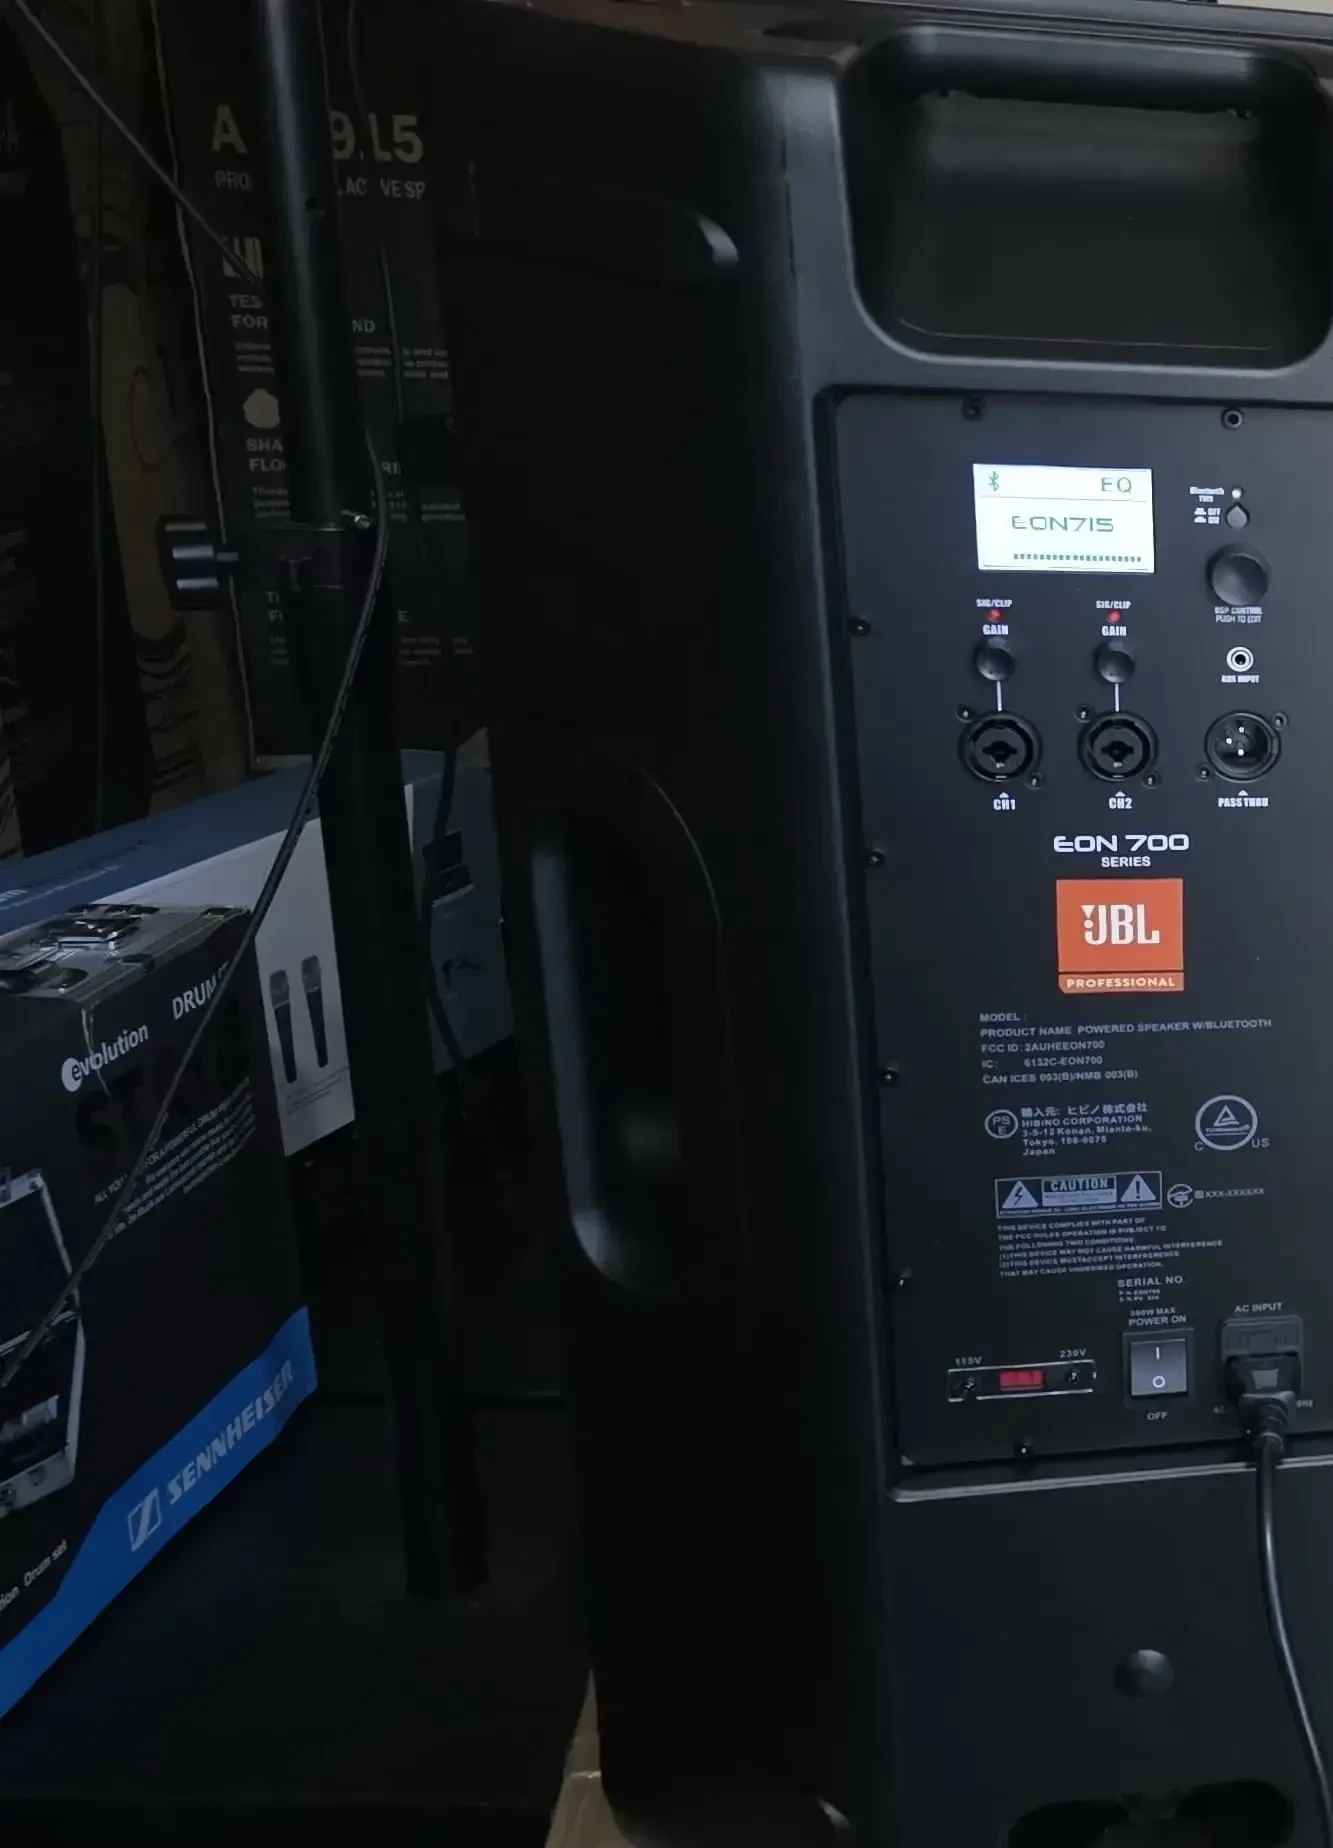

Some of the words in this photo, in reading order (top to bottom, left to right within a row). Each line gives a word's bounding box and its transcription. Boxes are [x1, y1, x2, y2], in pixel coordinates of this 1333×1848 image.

[1100, 477, 1133, 495] EQ
[1096, 600, 1132, 610] SIG/CLIP
[1215, 614, 1236, 623] PUSH
[1237, 615, 1246, 623] TO
[1247, 615, 1262, 624] EDIT
[982, 624, 1009, 636] GAIN
[1101, 625, 1128, 637] GAIN
[993, 798, 1017, 812] CH1
[1108, 796, 1133, 811] CH2
[1218, 797, 1242, 807] PASS
[1243, 797, 1269, 807] THRU
[1054, 834, 1118, 853] EON
[1125, 833, 1190, 852] 700
[1100, 855, 1152, 869] SERIES
[1081, 903, 1161, 946] JBL
[1065, 976, 1176, 990] PROFESSIONAL
[171, 976, 217, 1022] DRUM
[979, 1012, 1021, 1023] MODEL
[980, 1026, 1037, 1038] PRODUCT
[1039, 1025, 1073, 1036] NAME
[1077, 1023, 1135, 1036] POWERED
[1137, 1021, 1190, 1033] SPEAKER
[1192, 1017, 1272, 1031] W/BLUETOOTH
[981, 1043, 1005, 1054] FCC
[61, 1023, 149, 1092] evolution
[982, 1074, 1008, 1085] CAN
[1010, 1073, 1037, 1083] ICES
[1021, 1117, 1061, 1129] HIBINO
[1062, 1113, 1143, 1127] CORPORATION
[1250, 1137, 1270, 1149] US
[1022, 1147, 1056, 1157] Japan
[1050, 1177, 1109, 1193] CAUTION
[1116, 1277, 1162, 1289] SERIAL
[1156, 1306, 1177, 1316] MAX
[1234, 1303, 1251, 1314] AC
[1251, 1301, 1284, 1313] INPUT
[1128, 1315, 1169, 1328] POWER
[1170, 1314, 1188, 1325] ON
[953, 1355, 984, 1367] 115V
[1146, 1410, 1169, 1422] OFF
[167, 1359, 294, 1507] SENNHEISER
